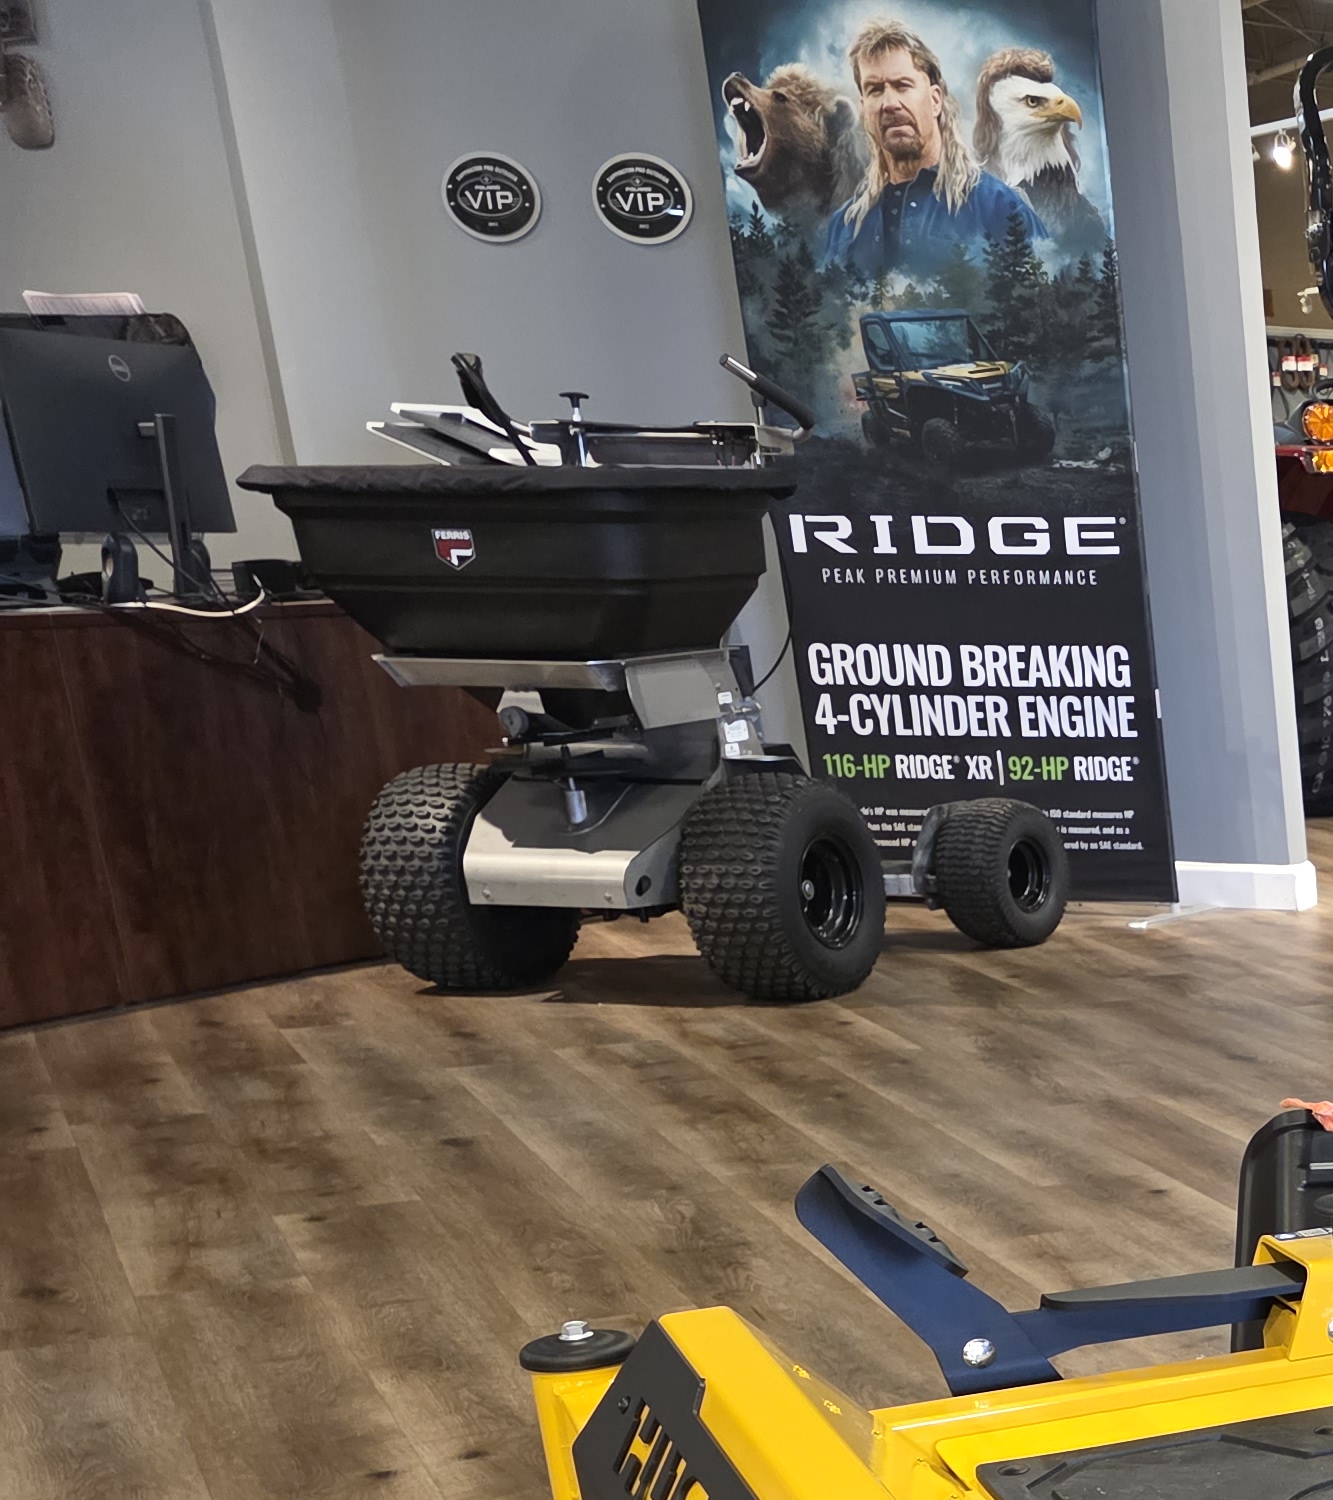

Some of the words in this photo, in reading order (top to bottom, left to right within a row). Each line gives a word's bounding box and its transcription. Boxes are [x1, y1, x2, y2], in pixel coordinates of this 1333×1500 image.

[464, 190, 513, 210] VIP
[615, 192, 665, 212] VIP
[434, 530, 470, 540] FERRIS
[788, 514, 1121, 555] RIDGE
[821, 568, 865, 584] PEAK
[875, 568, 957, 585] PREMIUM
[968, 569, 1098, 586] PERFORMANCE
[807, 643, 951, 687] GROUND
[959, 645, 1131, 688] BREAKING
[815, 693, 1012, 737] 4-CYLINDER
[1018, 695, 1138, 738] ENGINE
[823, 754, 891, 779] 116-HP
[895, 755, 955, 780] RIDGE
[965, 756, 994, 780] XR
[1008, 756, 1069, 781] 92-HP
[1073, 756, 1134, 781] RIDGE
